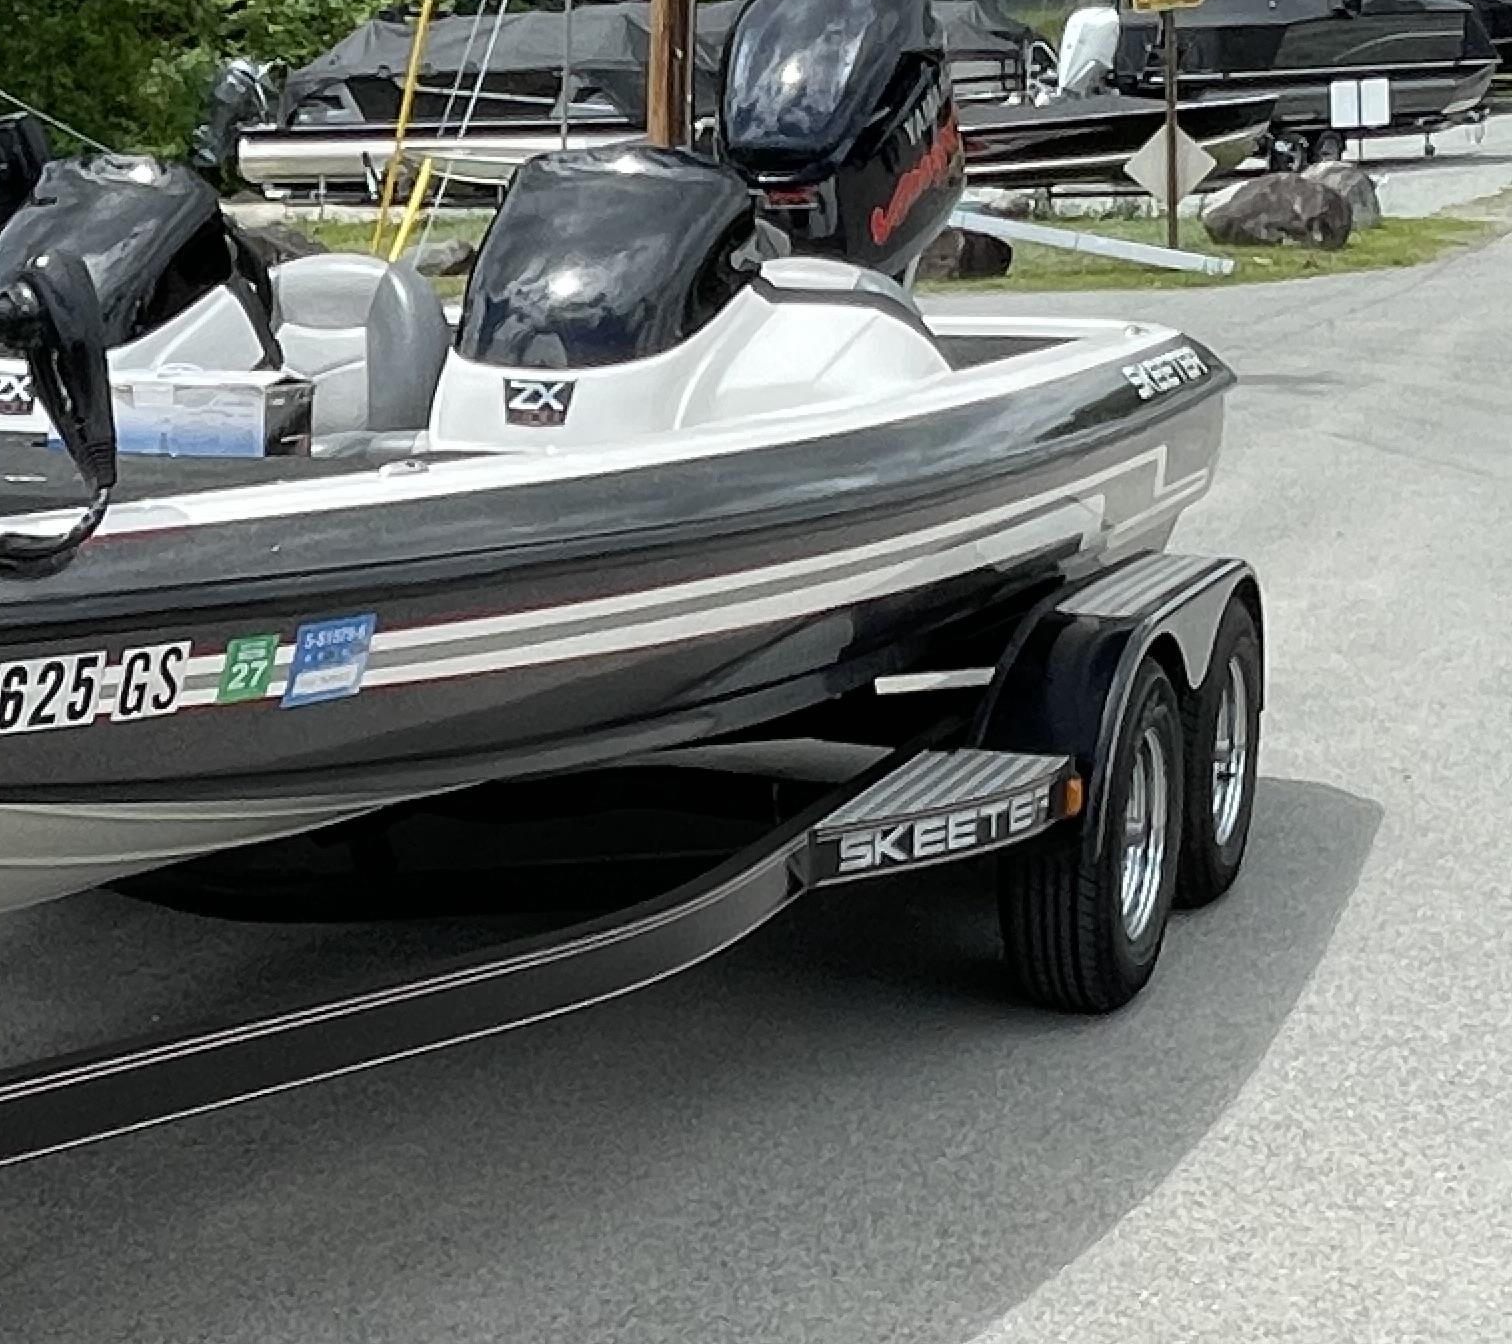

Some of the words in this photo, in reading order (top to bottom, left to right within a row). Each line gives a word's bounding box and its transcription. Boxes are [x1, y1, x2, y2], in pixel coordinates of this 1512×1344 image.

[508, 380, 565, 412] ZX
[119, 645, 185, 716] GS
[228, 659, 268, 690] 27
